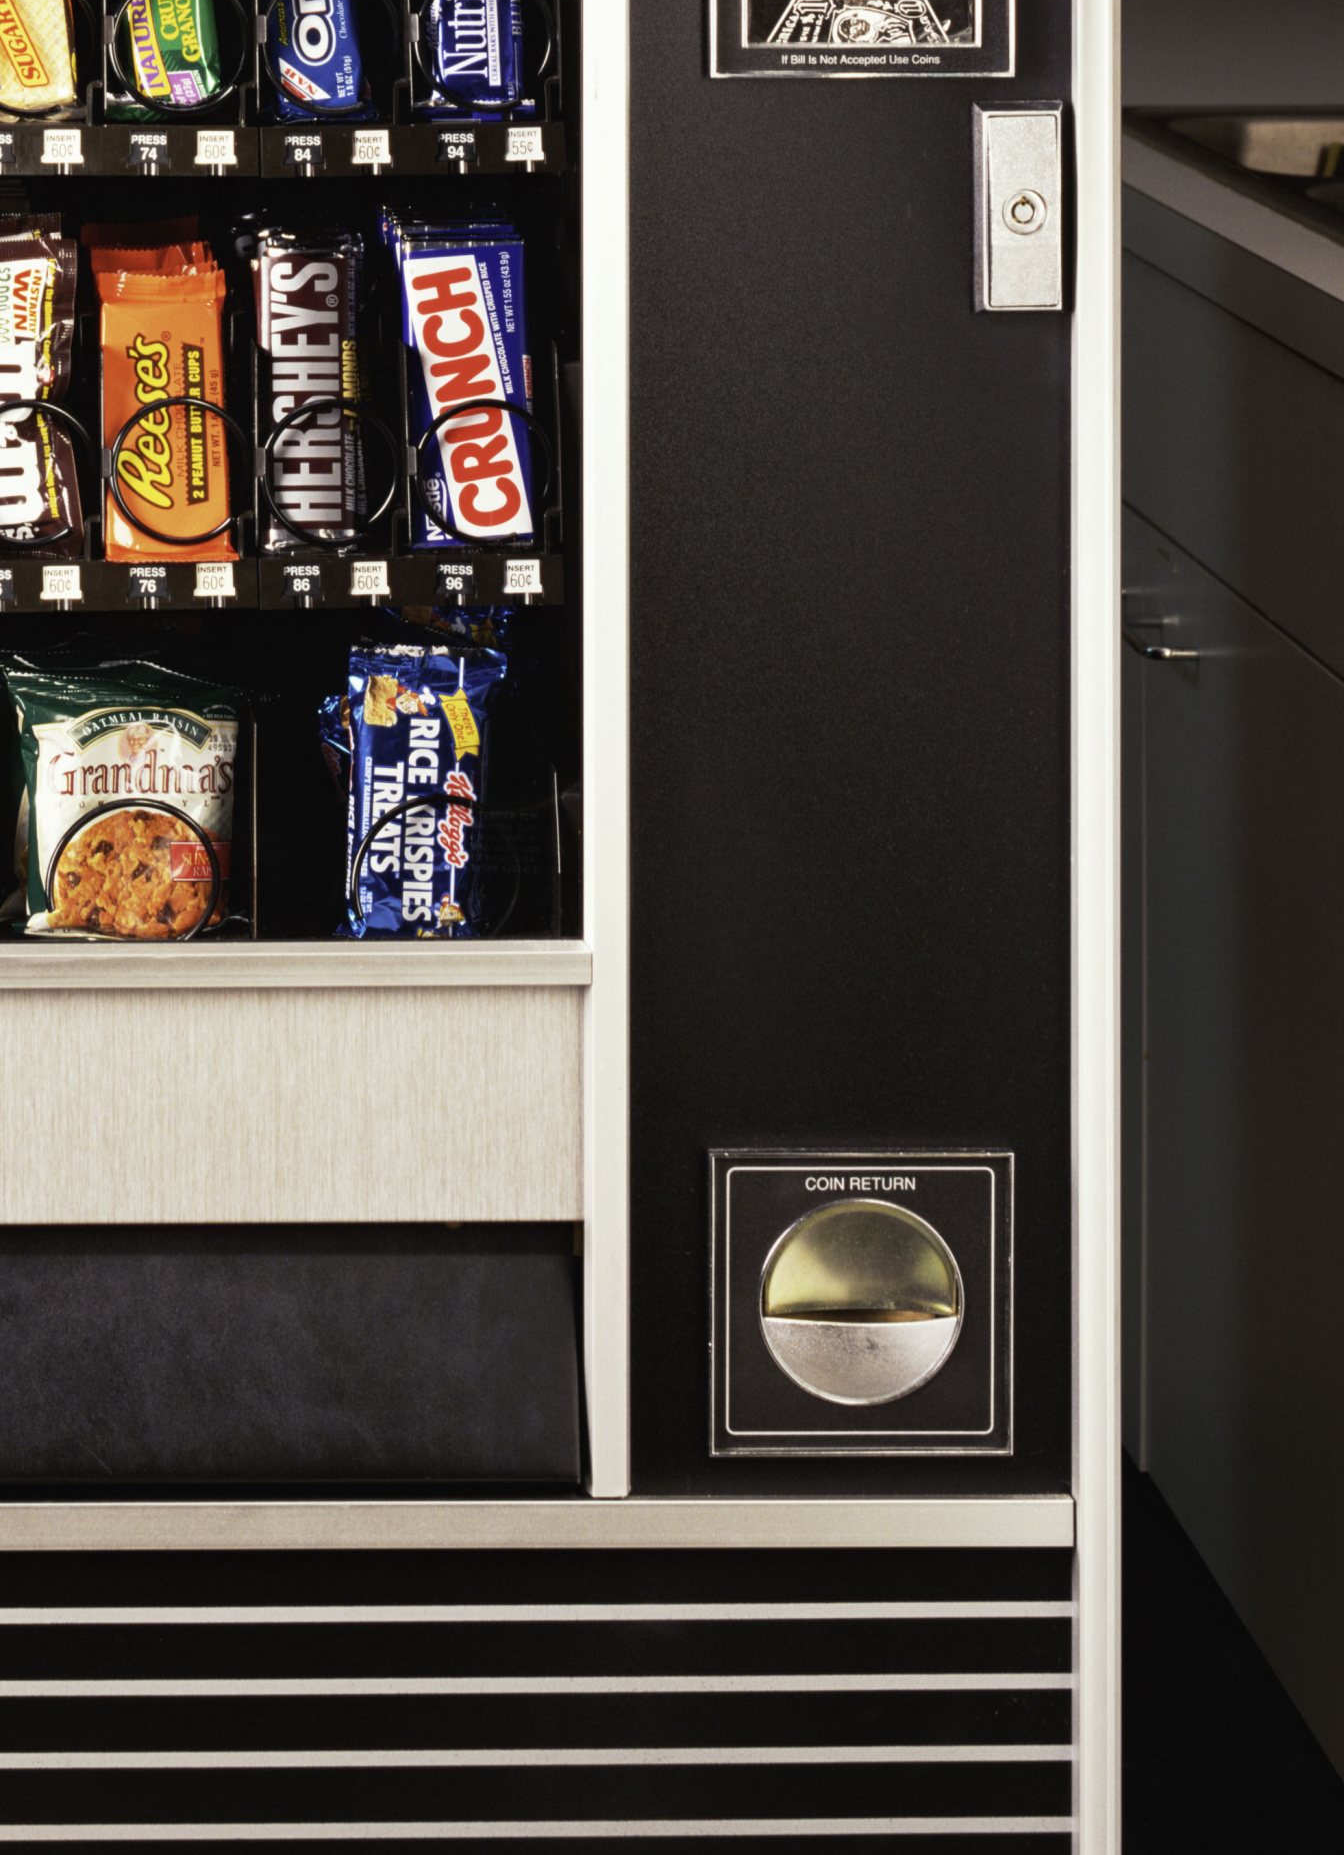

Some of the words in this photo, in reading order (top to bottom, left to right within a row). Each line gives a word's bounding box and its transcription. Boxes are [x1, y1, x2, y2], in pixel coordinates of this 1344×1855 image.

[0, 8, 41, 81] SUGAR
[782, 55, 788, 64] If
[791, 55, 805, 64] Bill
[808, 55, 817, 64] Is
[820, 55, 837, 64] Not
[840, 55, 886, 66] Accepted
[889, 55, 909, 64] Use
[912, 54, 940, 64] Coins
[478, 261, 487, 279] RICE
[483, 280, 496, 311] CRISPED
[490, 312, 500, 331] WITH
[494, 332, 509, 374] CHOCOLATE
[270, 261, 342, 522] HERSHEY'S
[411, 266, 521, 527] CRUNCH
[505, 375, 513, 394] MILK
[117, 332, 174, 509] Reese's
[440, 565, 473, 575] PRESS
[506, 564, 535, 573] INSERT
[510, 574, 532, 587] 60¢
[446, 577, 463, 590] 96
[83, 712, 144, 736] OATMEAL
[153, 713, 199, 736] RAISIN
[409, 719, 441, 785] RICE
[370, 761, 404, 873] TREATS
[402, 797, 436, 922] KRISPIES
[805, 1177, 844, 1191] COIN
[850, 1177, 915, 1190] RETURN
